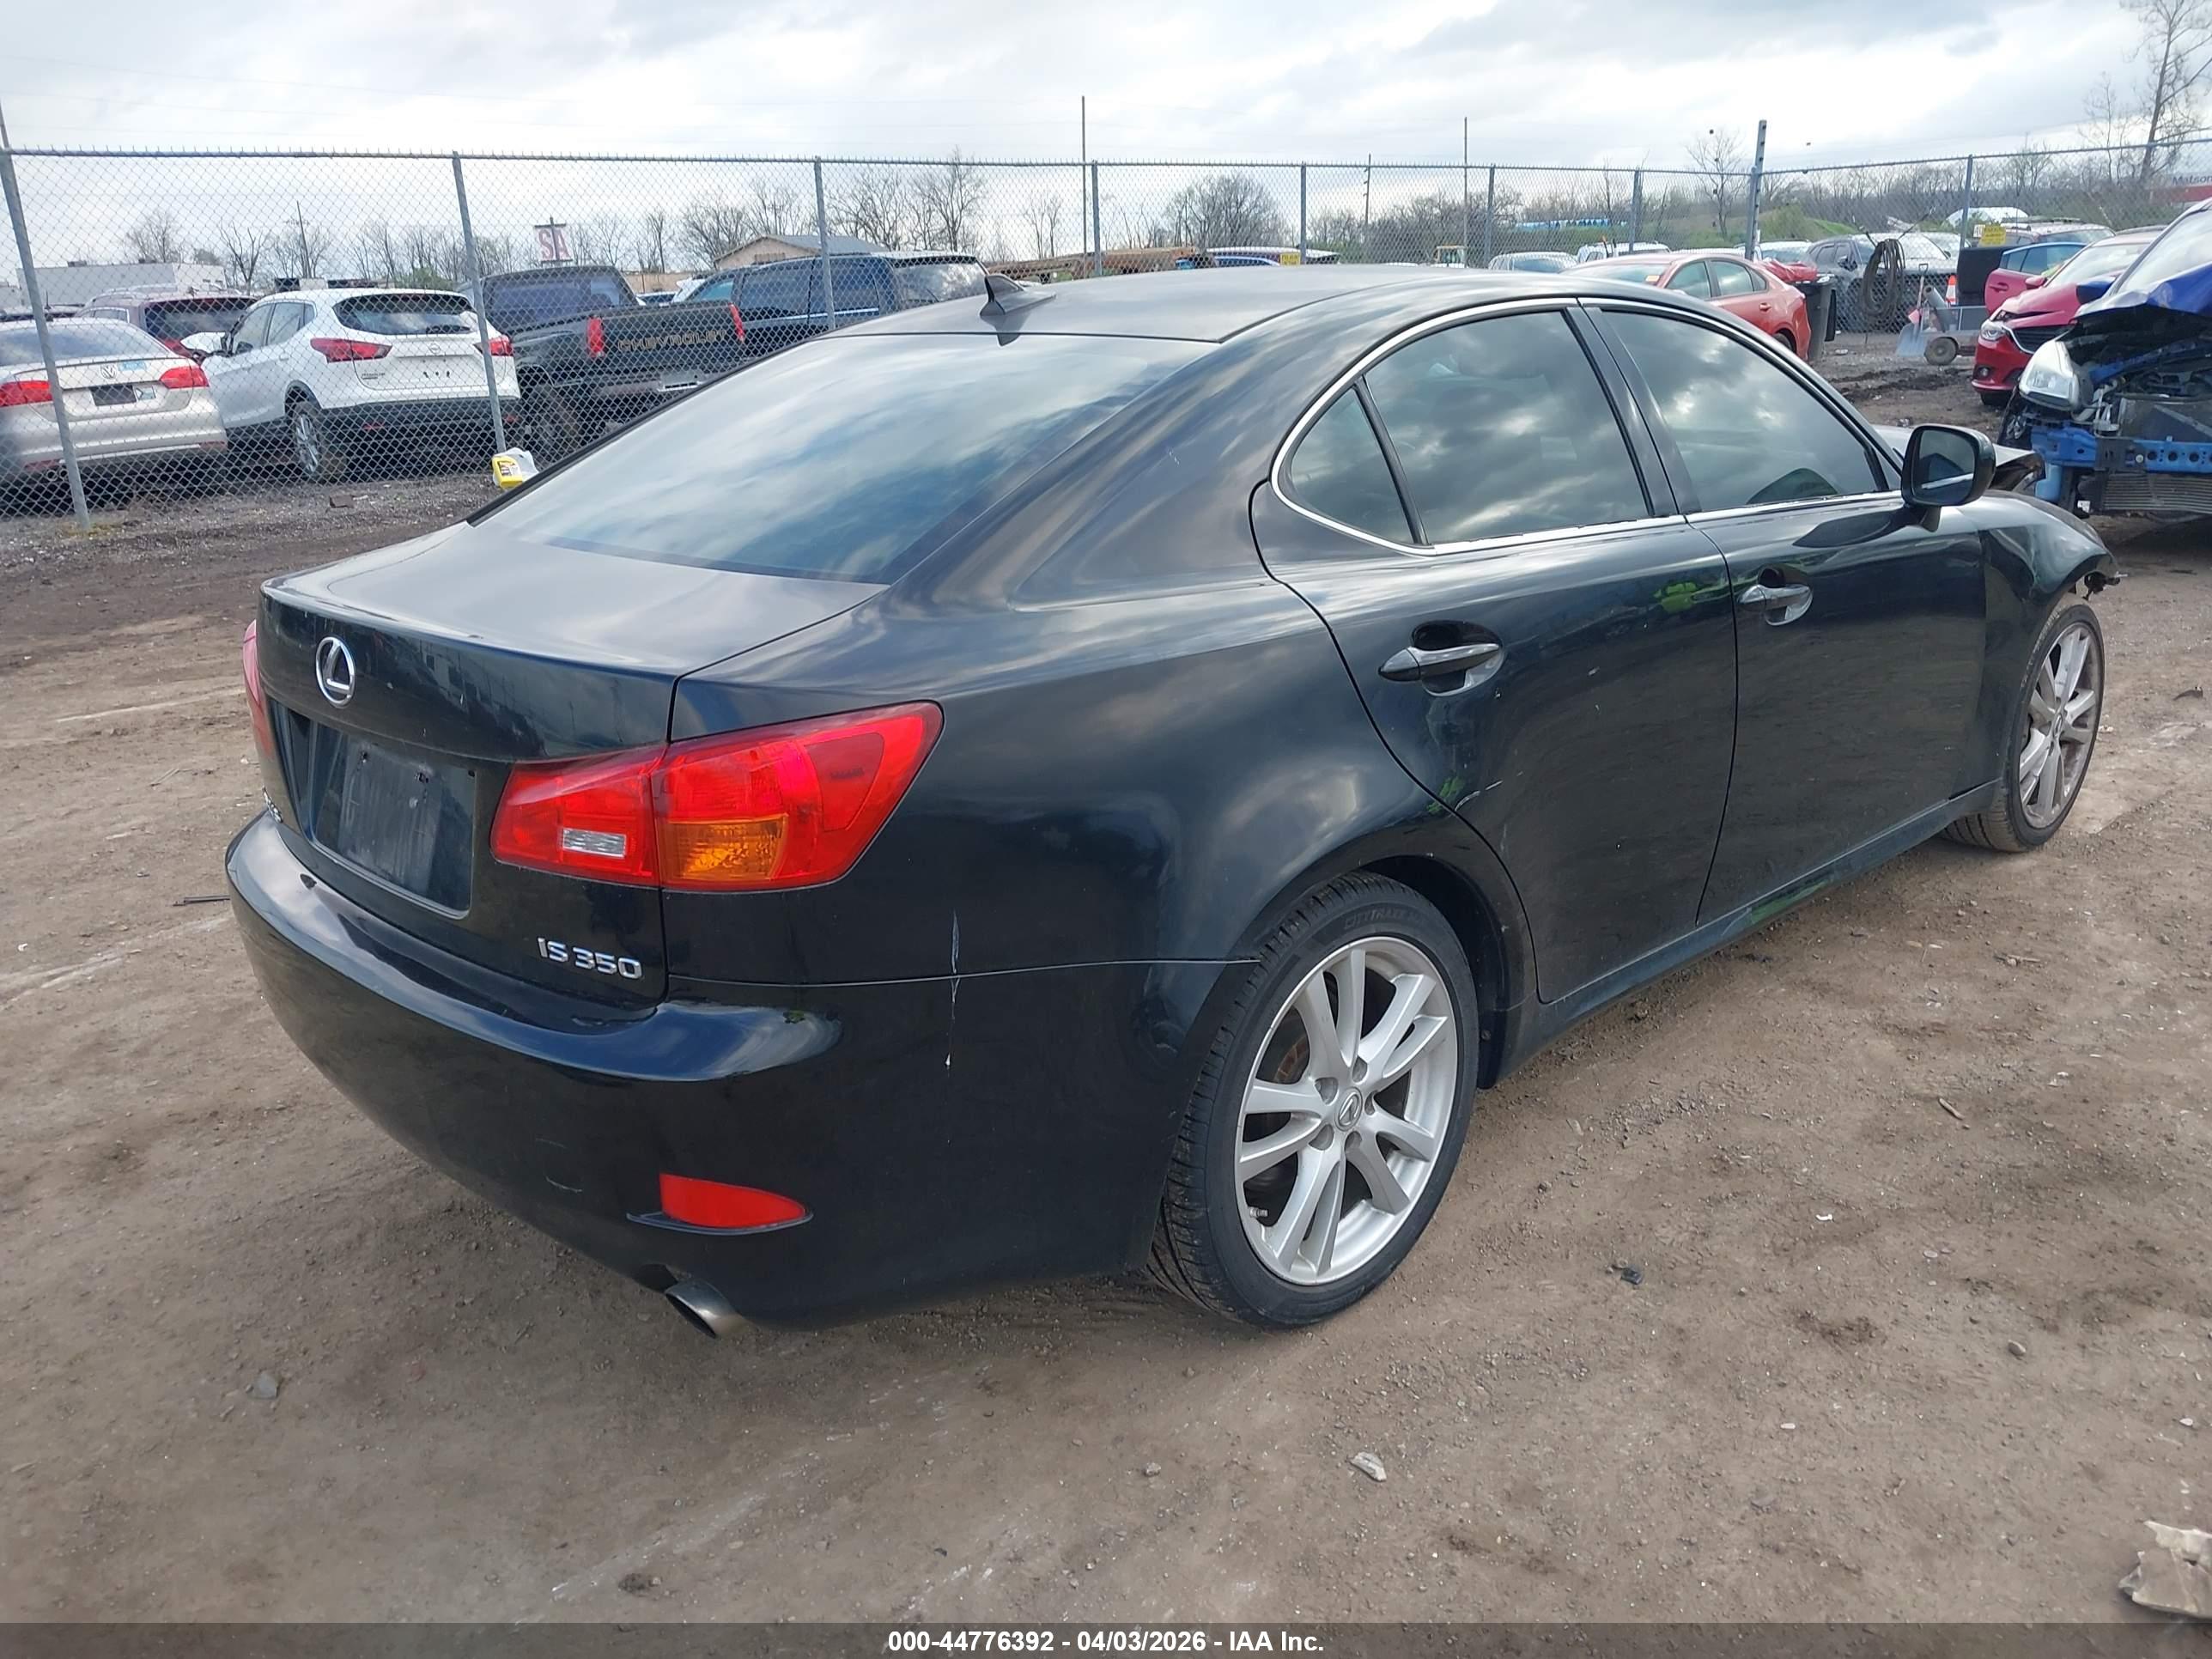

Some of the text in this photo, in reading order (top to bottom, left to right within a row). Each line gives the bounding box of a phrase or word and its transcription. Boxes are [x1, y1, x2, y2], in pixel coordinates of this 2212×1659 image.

[617, 329, 726, 352] CHEVROLET
[537, 937, 642, 980] IS 350
